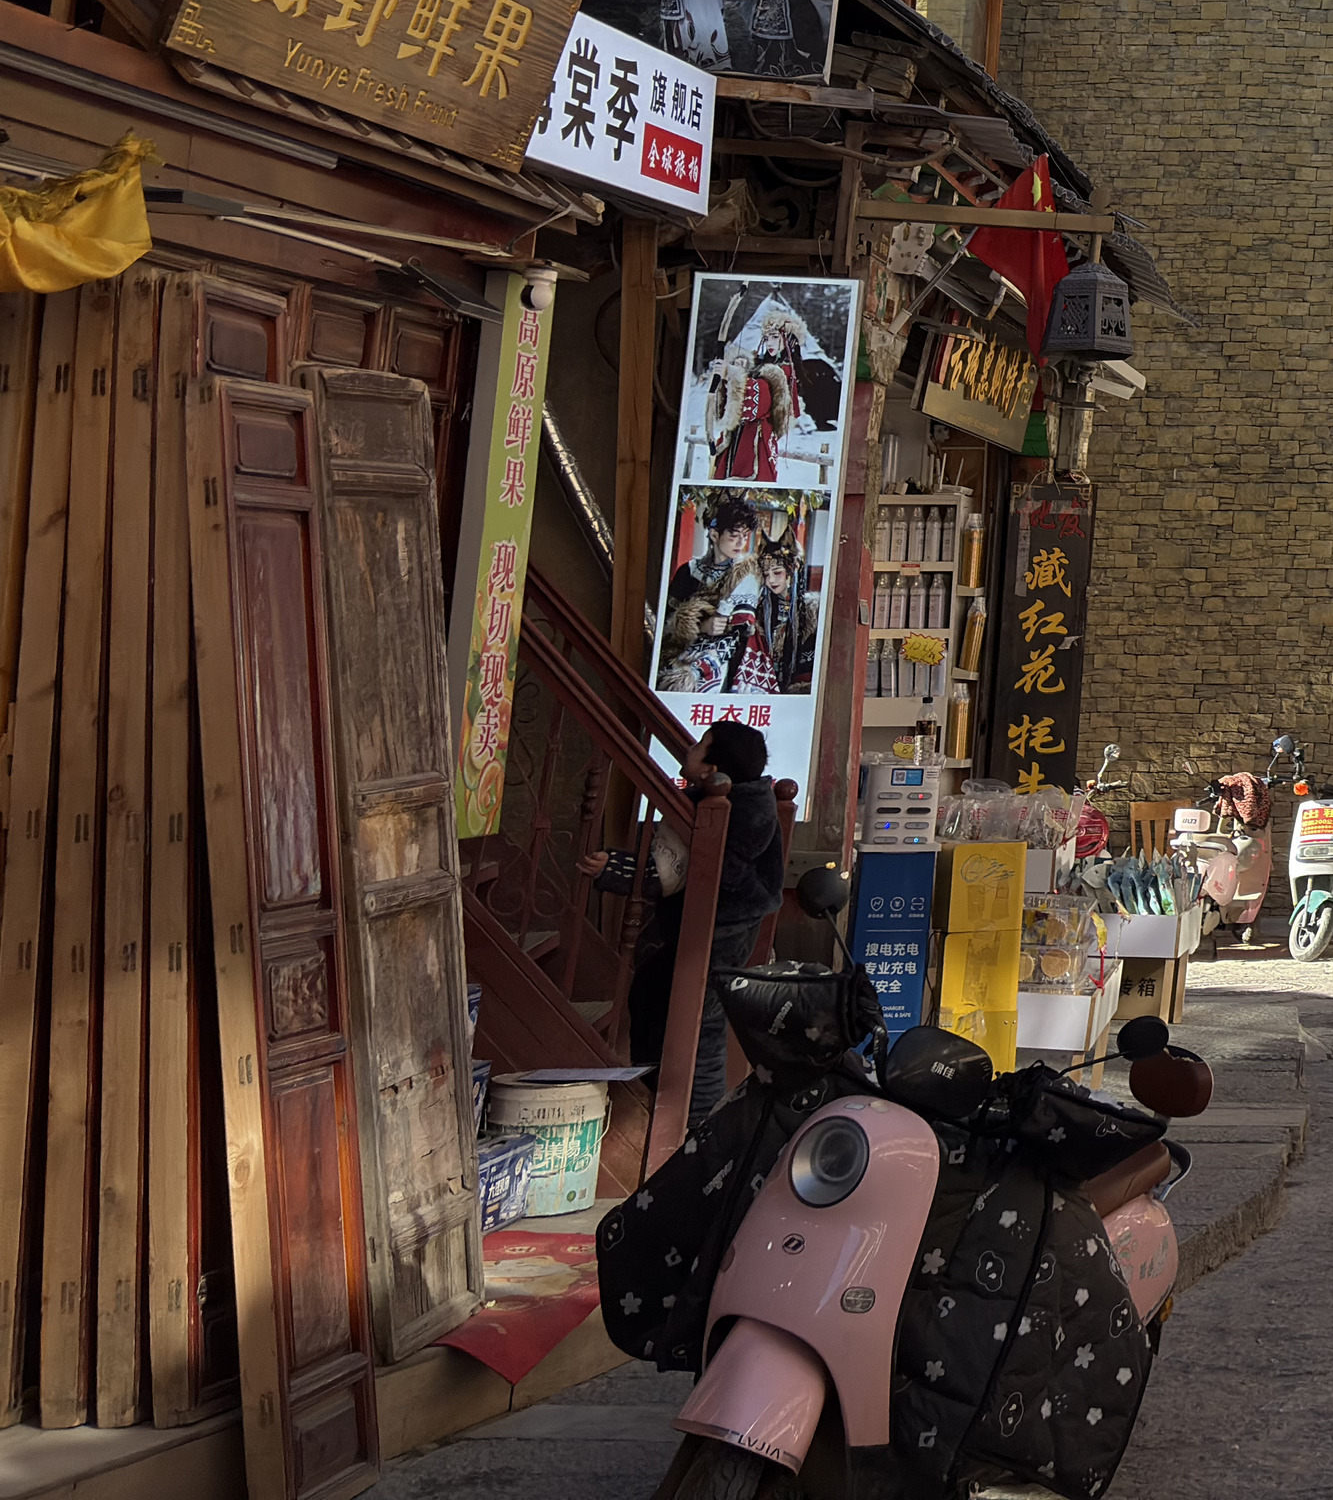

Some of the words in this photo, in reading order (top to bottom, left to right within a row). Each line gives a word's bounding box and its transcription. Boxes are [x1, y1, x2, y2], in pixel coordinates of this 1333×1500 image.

[282, 37, 351, 90] Yunye
[351, 66, 409, 112] Fresh
[409, 88, 459, 130] Fruit
[649, 69, 704, 132] 旗舰店
[646, 138, 699, 183] 全球旅拍
[499, 306, 541, 509] 高原鲜果
[473, 540, 518, 761] 现切现卖
[1013, 546, 1073, 694] 藏红花
[689, 703, 772, 728] 租衣服
[864, 942, 920, 957] 搜电充电
[864, 961, 918, 976] 专业充电
